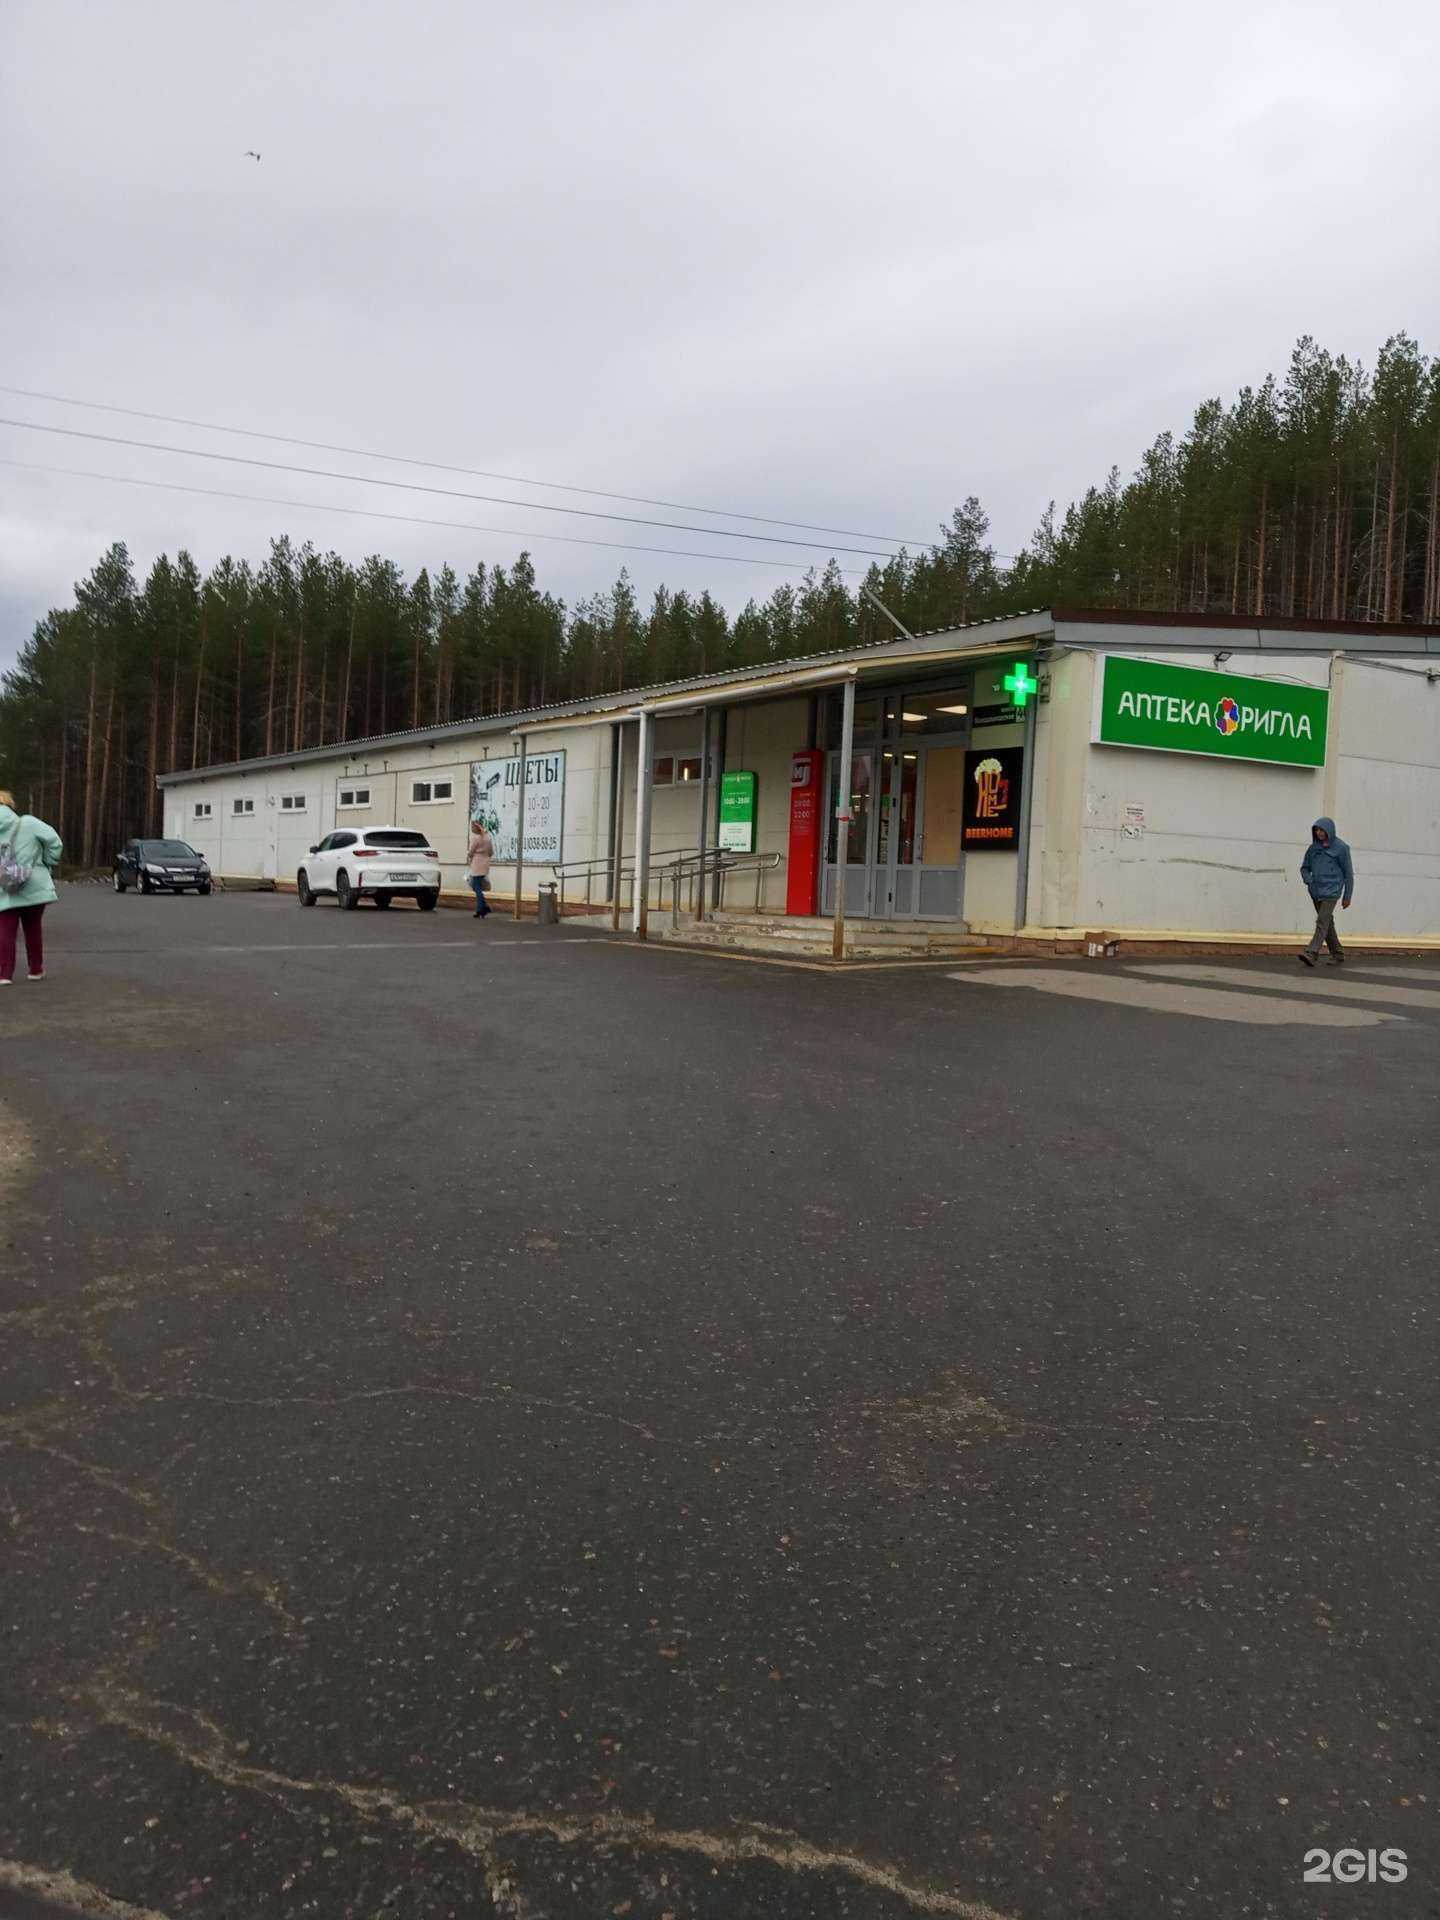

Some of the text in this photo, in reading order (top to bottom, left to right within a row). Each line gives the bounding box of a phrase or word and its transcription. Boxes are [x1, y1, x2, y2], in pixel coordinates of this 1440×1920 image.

[1117, 691, 1312, 740] АПТЕКА РИГЛА
[965, 827, 1013, 839] BEERHOME
